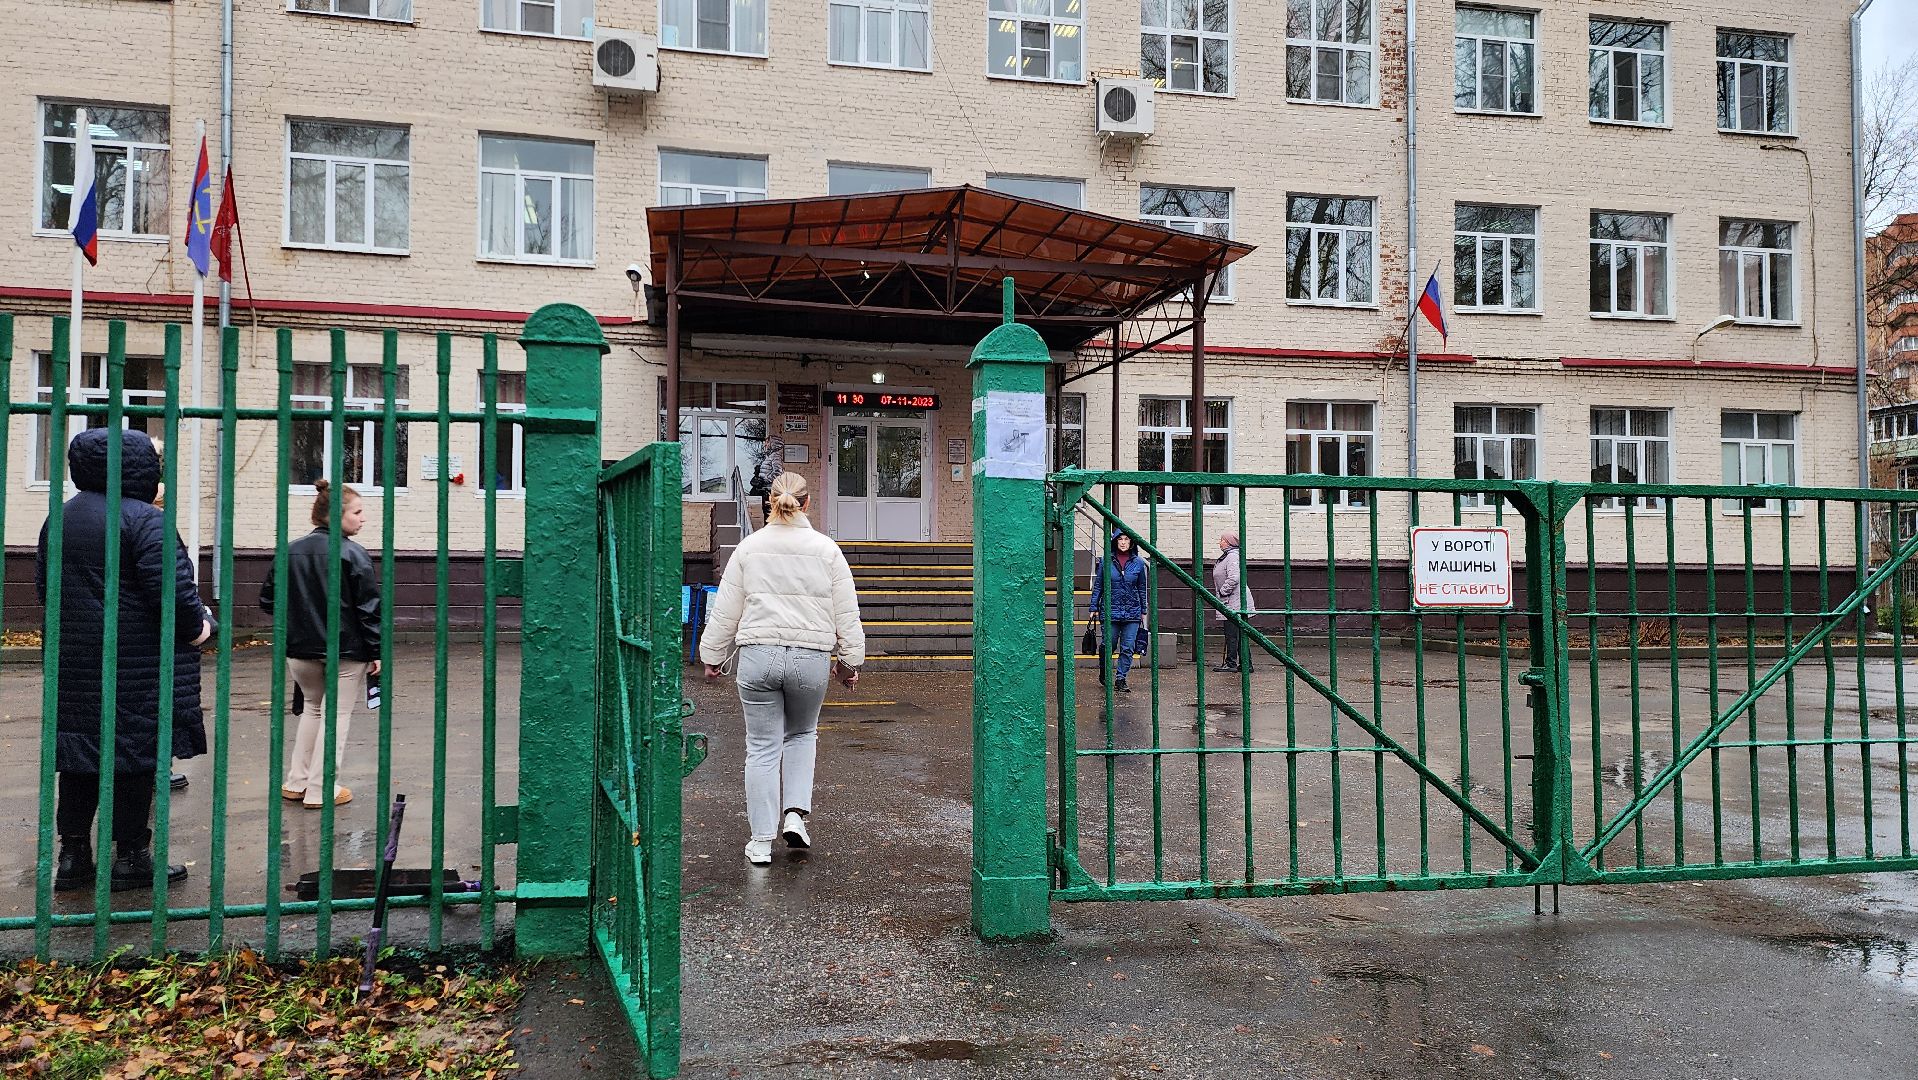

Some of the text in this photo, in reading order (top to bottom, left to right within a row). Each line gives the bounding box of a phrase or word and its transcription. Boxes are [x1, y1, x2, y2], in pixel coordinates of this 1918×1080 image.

[837, 394, 934, 407] 11 30 07-11-2023
[1431, 540, 1491, 552] У ВОРОТ
[1428, 560, 1497, 573] МАШИНЫ
[1419, 583, 1506, 595] НЕ СТАВИТЬ
